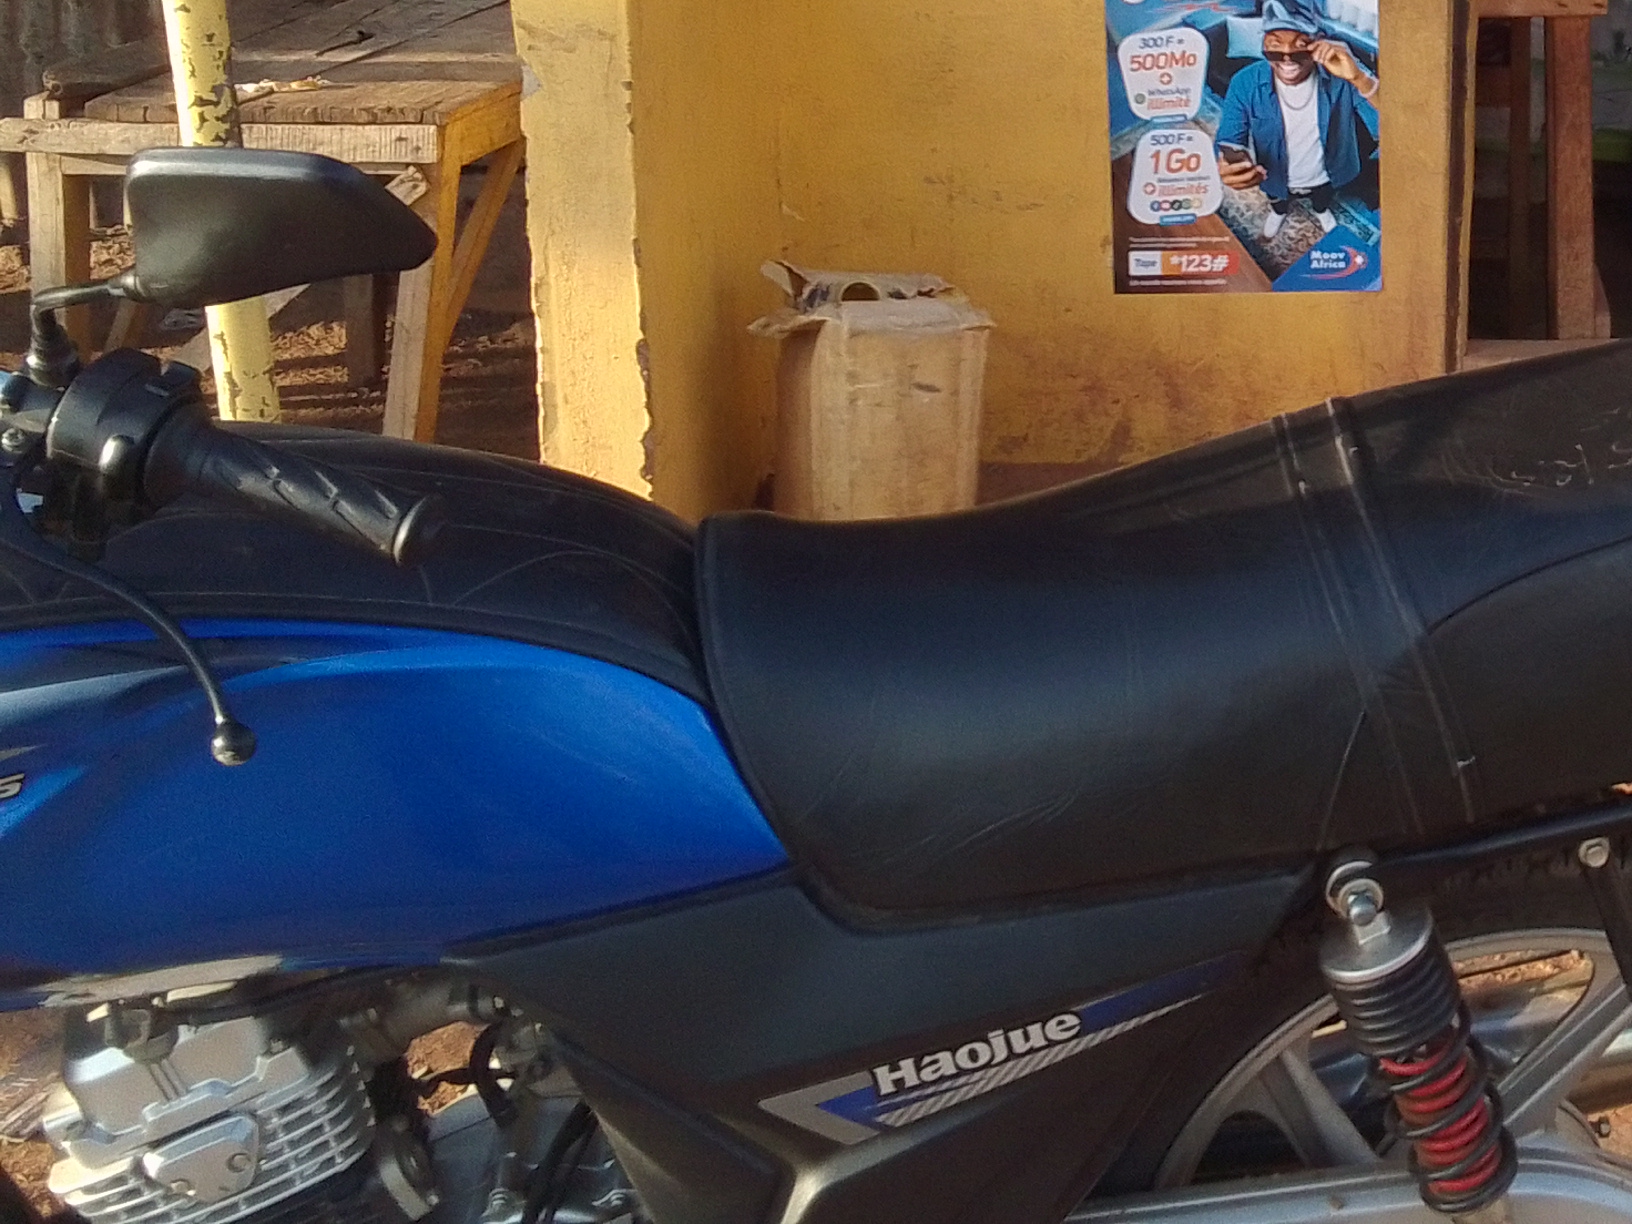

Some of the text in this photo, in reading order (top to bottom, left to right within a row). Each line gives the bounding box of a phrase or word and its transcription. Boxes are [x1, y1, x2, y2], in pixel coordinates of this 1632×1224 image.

[1130, 50, 1197, 72] 500Mo
[1310, 250, 1346, 260] Moov
[1310, 259, 1346, 269] Africa
[873, 1014, 1082, 1096] Haojue
